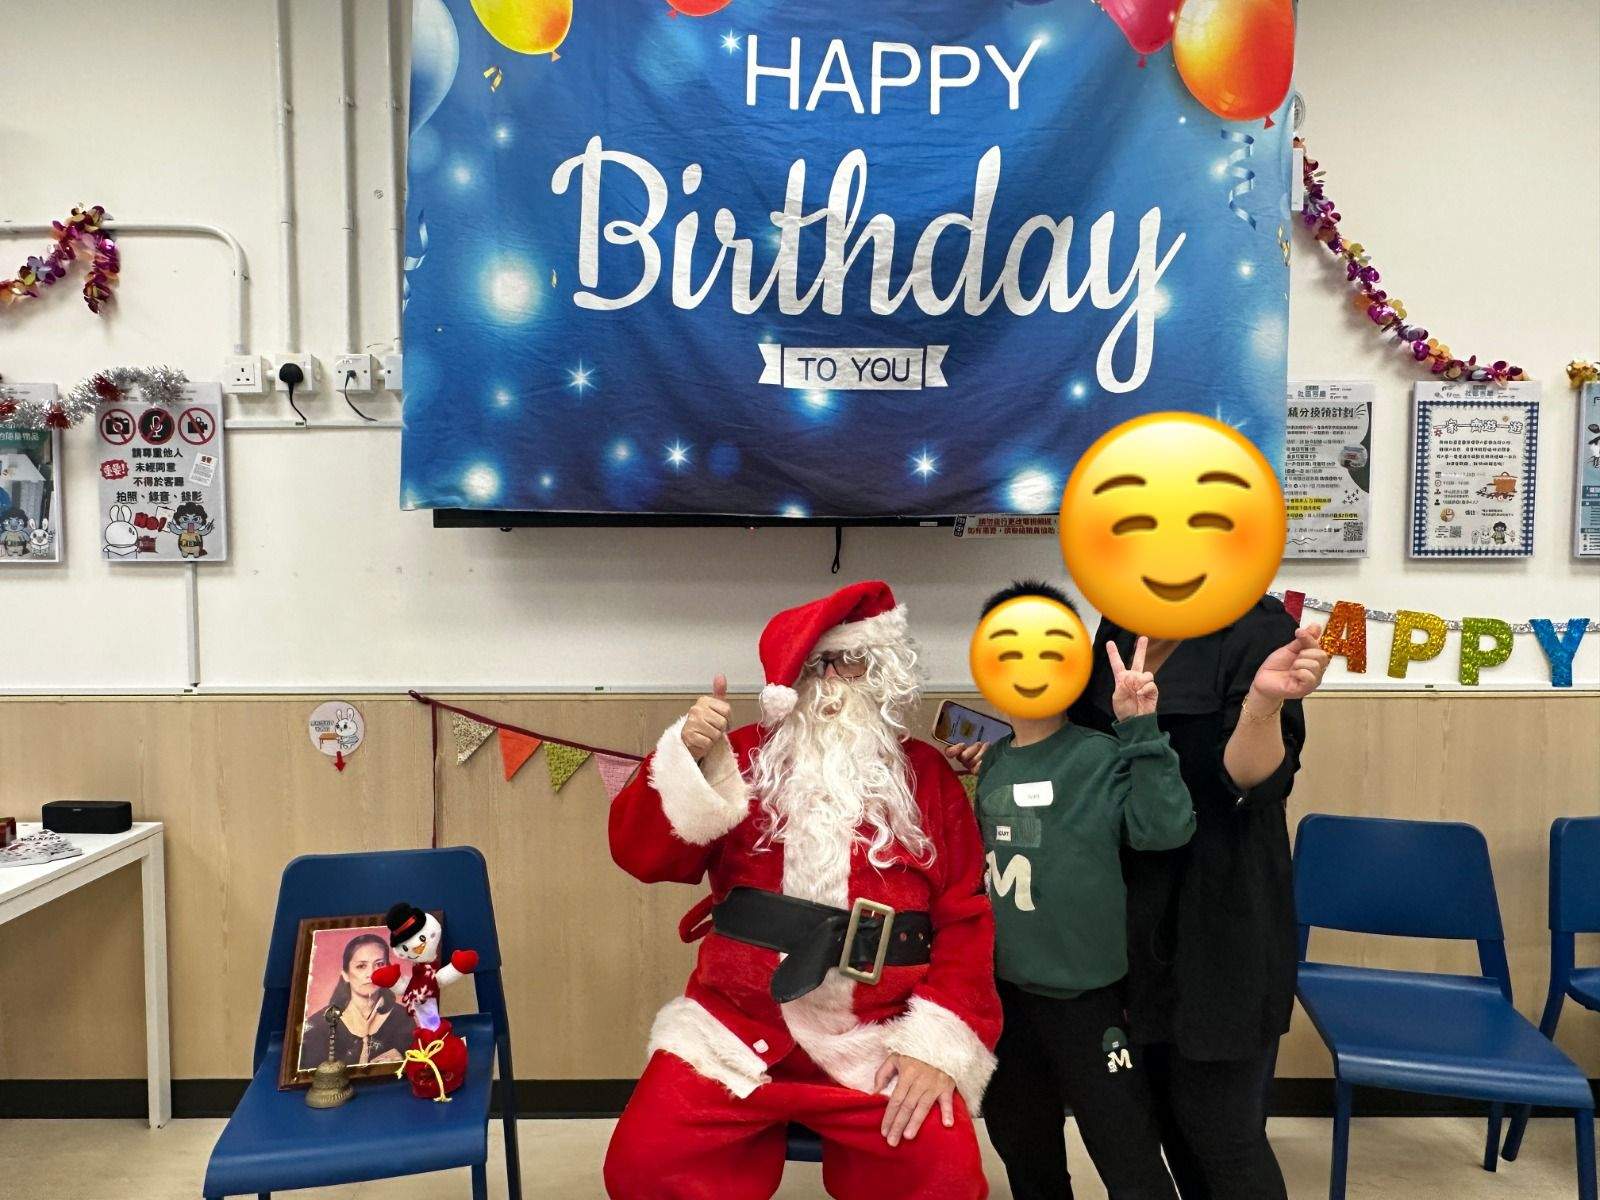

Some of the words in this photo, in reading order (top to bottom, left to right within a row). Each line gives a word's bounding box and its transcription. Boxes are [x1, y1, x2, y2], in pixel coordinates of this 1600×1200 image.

[745, 34, 1042, 115] HAPPY
[551, 135, 1187, 393] Birthday
[797, 356, 837, 382] TO
[851, 357, 911, 382] YOU
[132, 448, 184, 458] 請尊重他人
[135, 462, 177, 473] 未經同意
[133, 476, 185, 487] 不得於客廳
[1284, 590, 1591, 687] APPY
